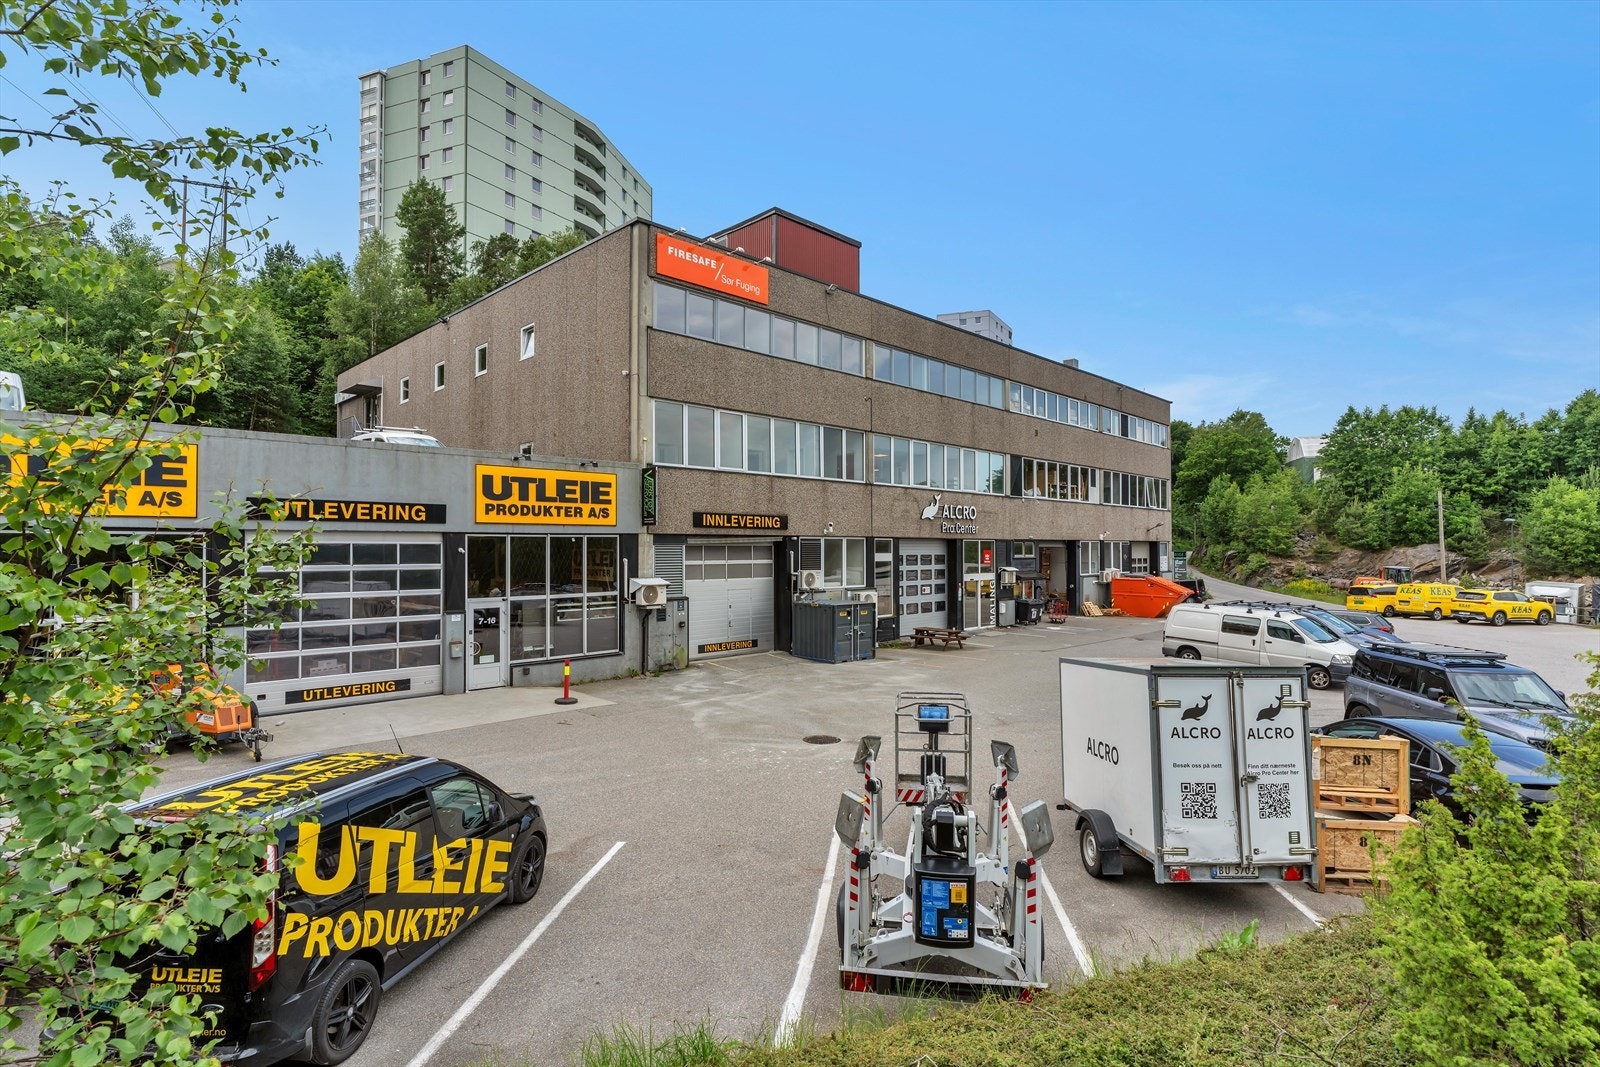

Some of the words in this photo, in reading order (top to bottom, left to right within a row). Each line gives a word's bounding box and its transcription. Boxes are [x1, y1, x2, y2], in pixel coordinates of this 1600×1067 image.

[668, 246, 717, 269] FIRESAFE
[721, 274, 735, 286] Sør
[736, 279, 760, 296] Fuging
[482, 474, 612, 505] UTLEIE
[138, 490, 183, 508] A/S
[485, 503, 583, 518] PRODUKTER
[588, 507, 610, 519] A/S
[942, 504, 977, 520] ALCRO
[702, 514, 781, 529] INNLEVERING
[942, 521, 955, 533] Pro
[955, 522, 980, 534] Center
[1399, 586, 1423, 595] KEAS
[1430, 586, 1452, 596] KEAS
[1511, 606, 1533, 614] KEAS
[478, 617, 496, 625] 7-16
[704, 640, 753, 652] INNLEVERING
[303, 681, 396, 701] UTLEVERING
[1170, 727, 1221, 739] ALCRO
[1247, 727, 1294, 740] ALCRO
[1087, 736, 1119, 765] ALCRO
[1203, 762, 1211, 771] på
[1352, 754, 1372, 766] 8N
[295, 821, 513, 896] UTLEIE
[1219, 866, 1231, 875] BU
[277, 906, 465, 958] PRODUKTER
[151, 967, 223, 983] UTLEIE
[204, 985, 221, 993] A/S
